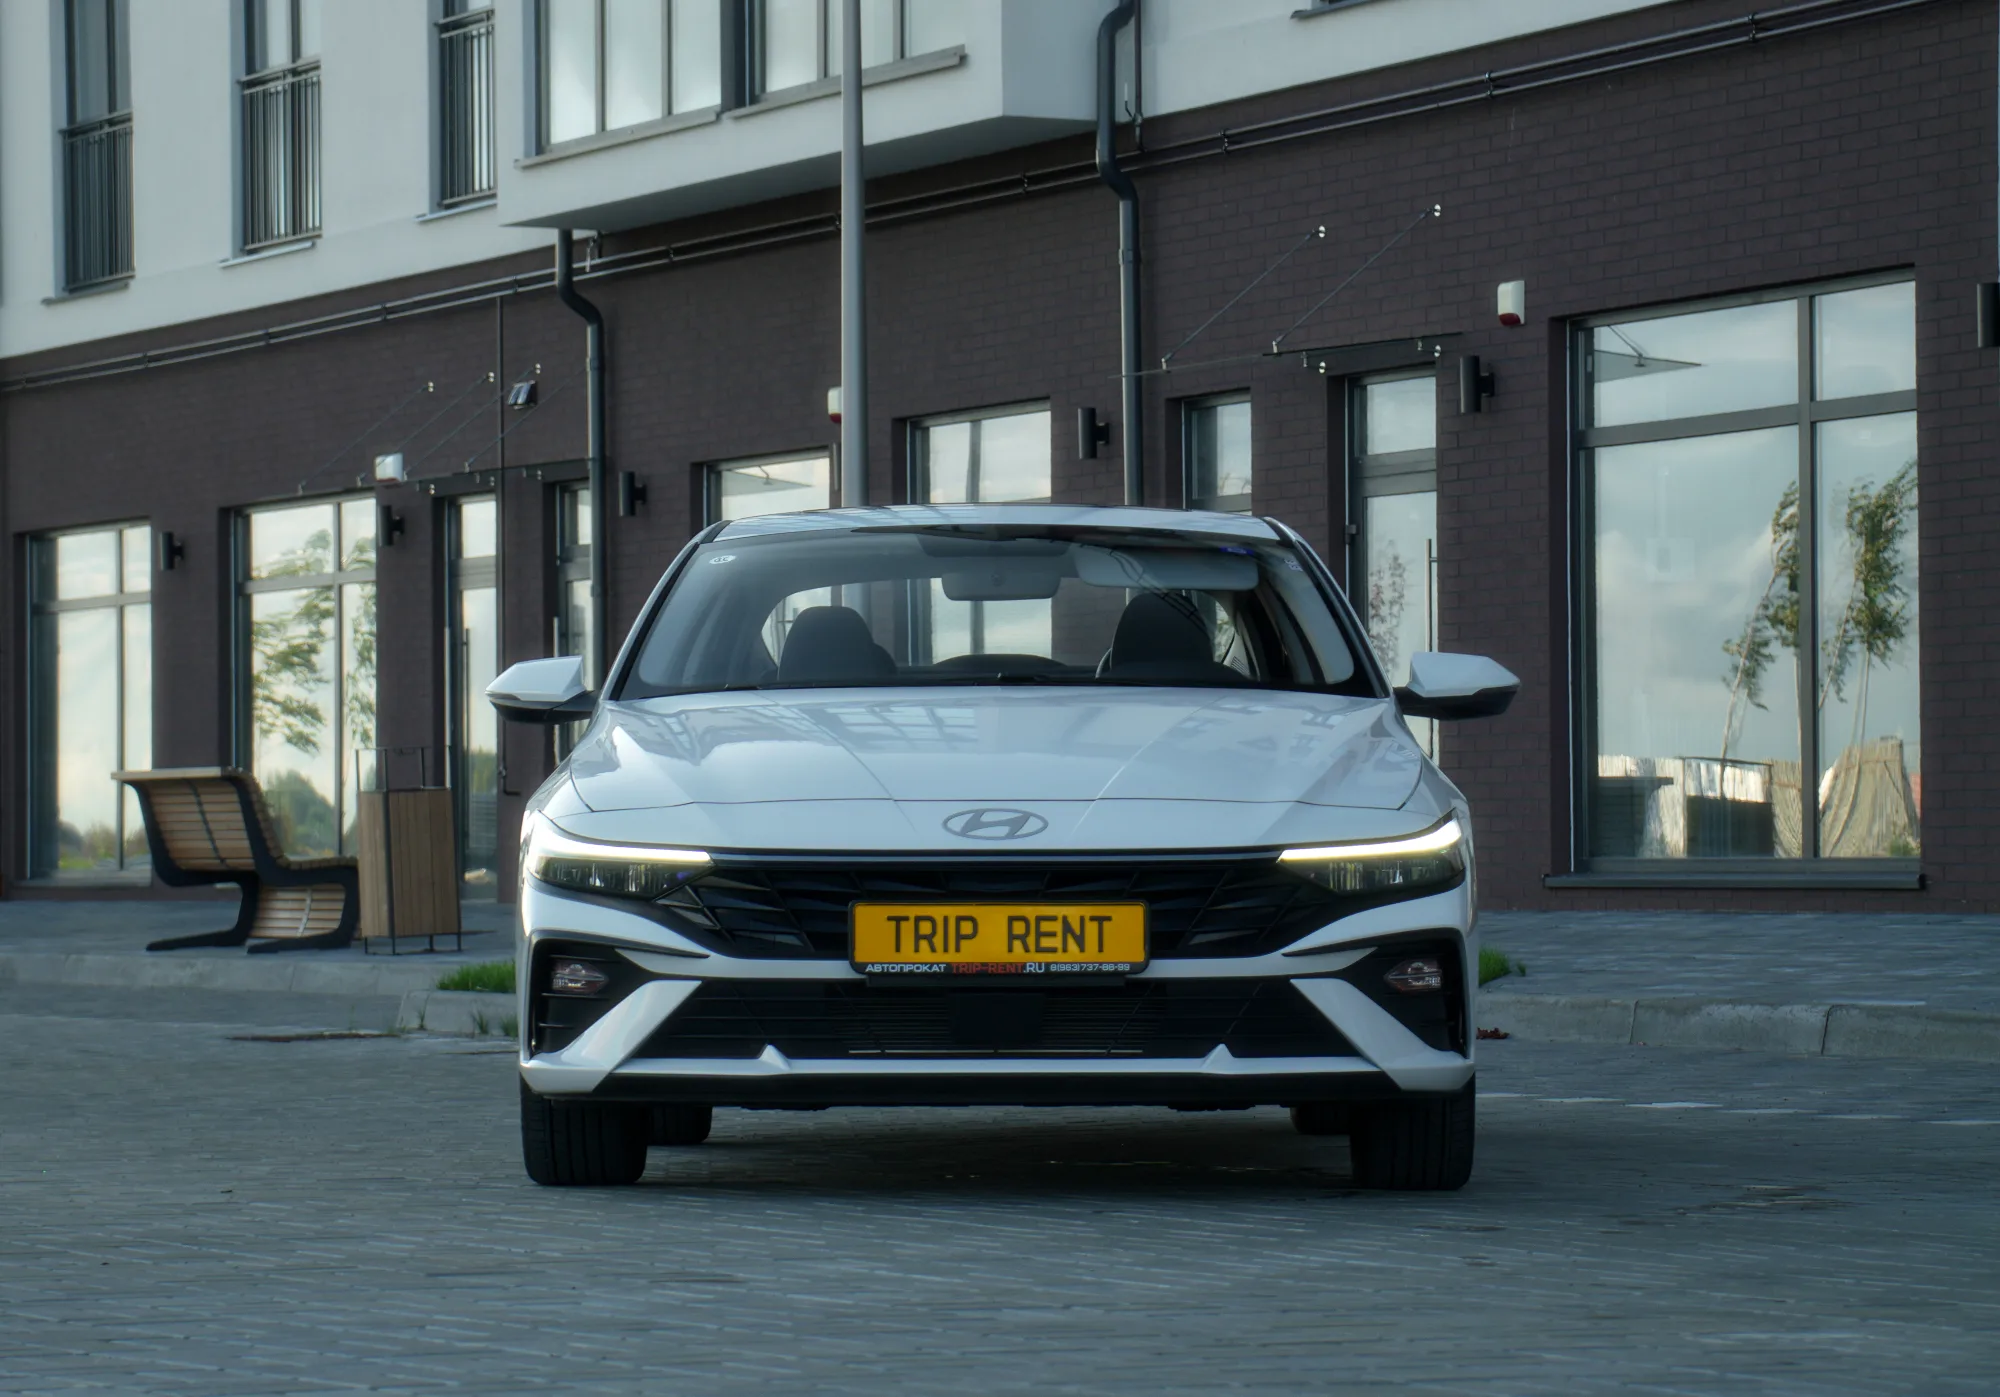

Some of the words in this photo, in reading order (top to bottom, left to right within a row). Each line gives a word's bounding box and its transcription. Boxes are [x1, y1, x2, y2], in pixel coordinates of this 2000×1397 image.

[886, 915, 979, 953] TRIP
[1007, 915, 1112, 953] RENT
[865, 963, 947, 973] АВТОПРОКАТ
[951, 962, 1045, 974] TRIP-RENT.RU
